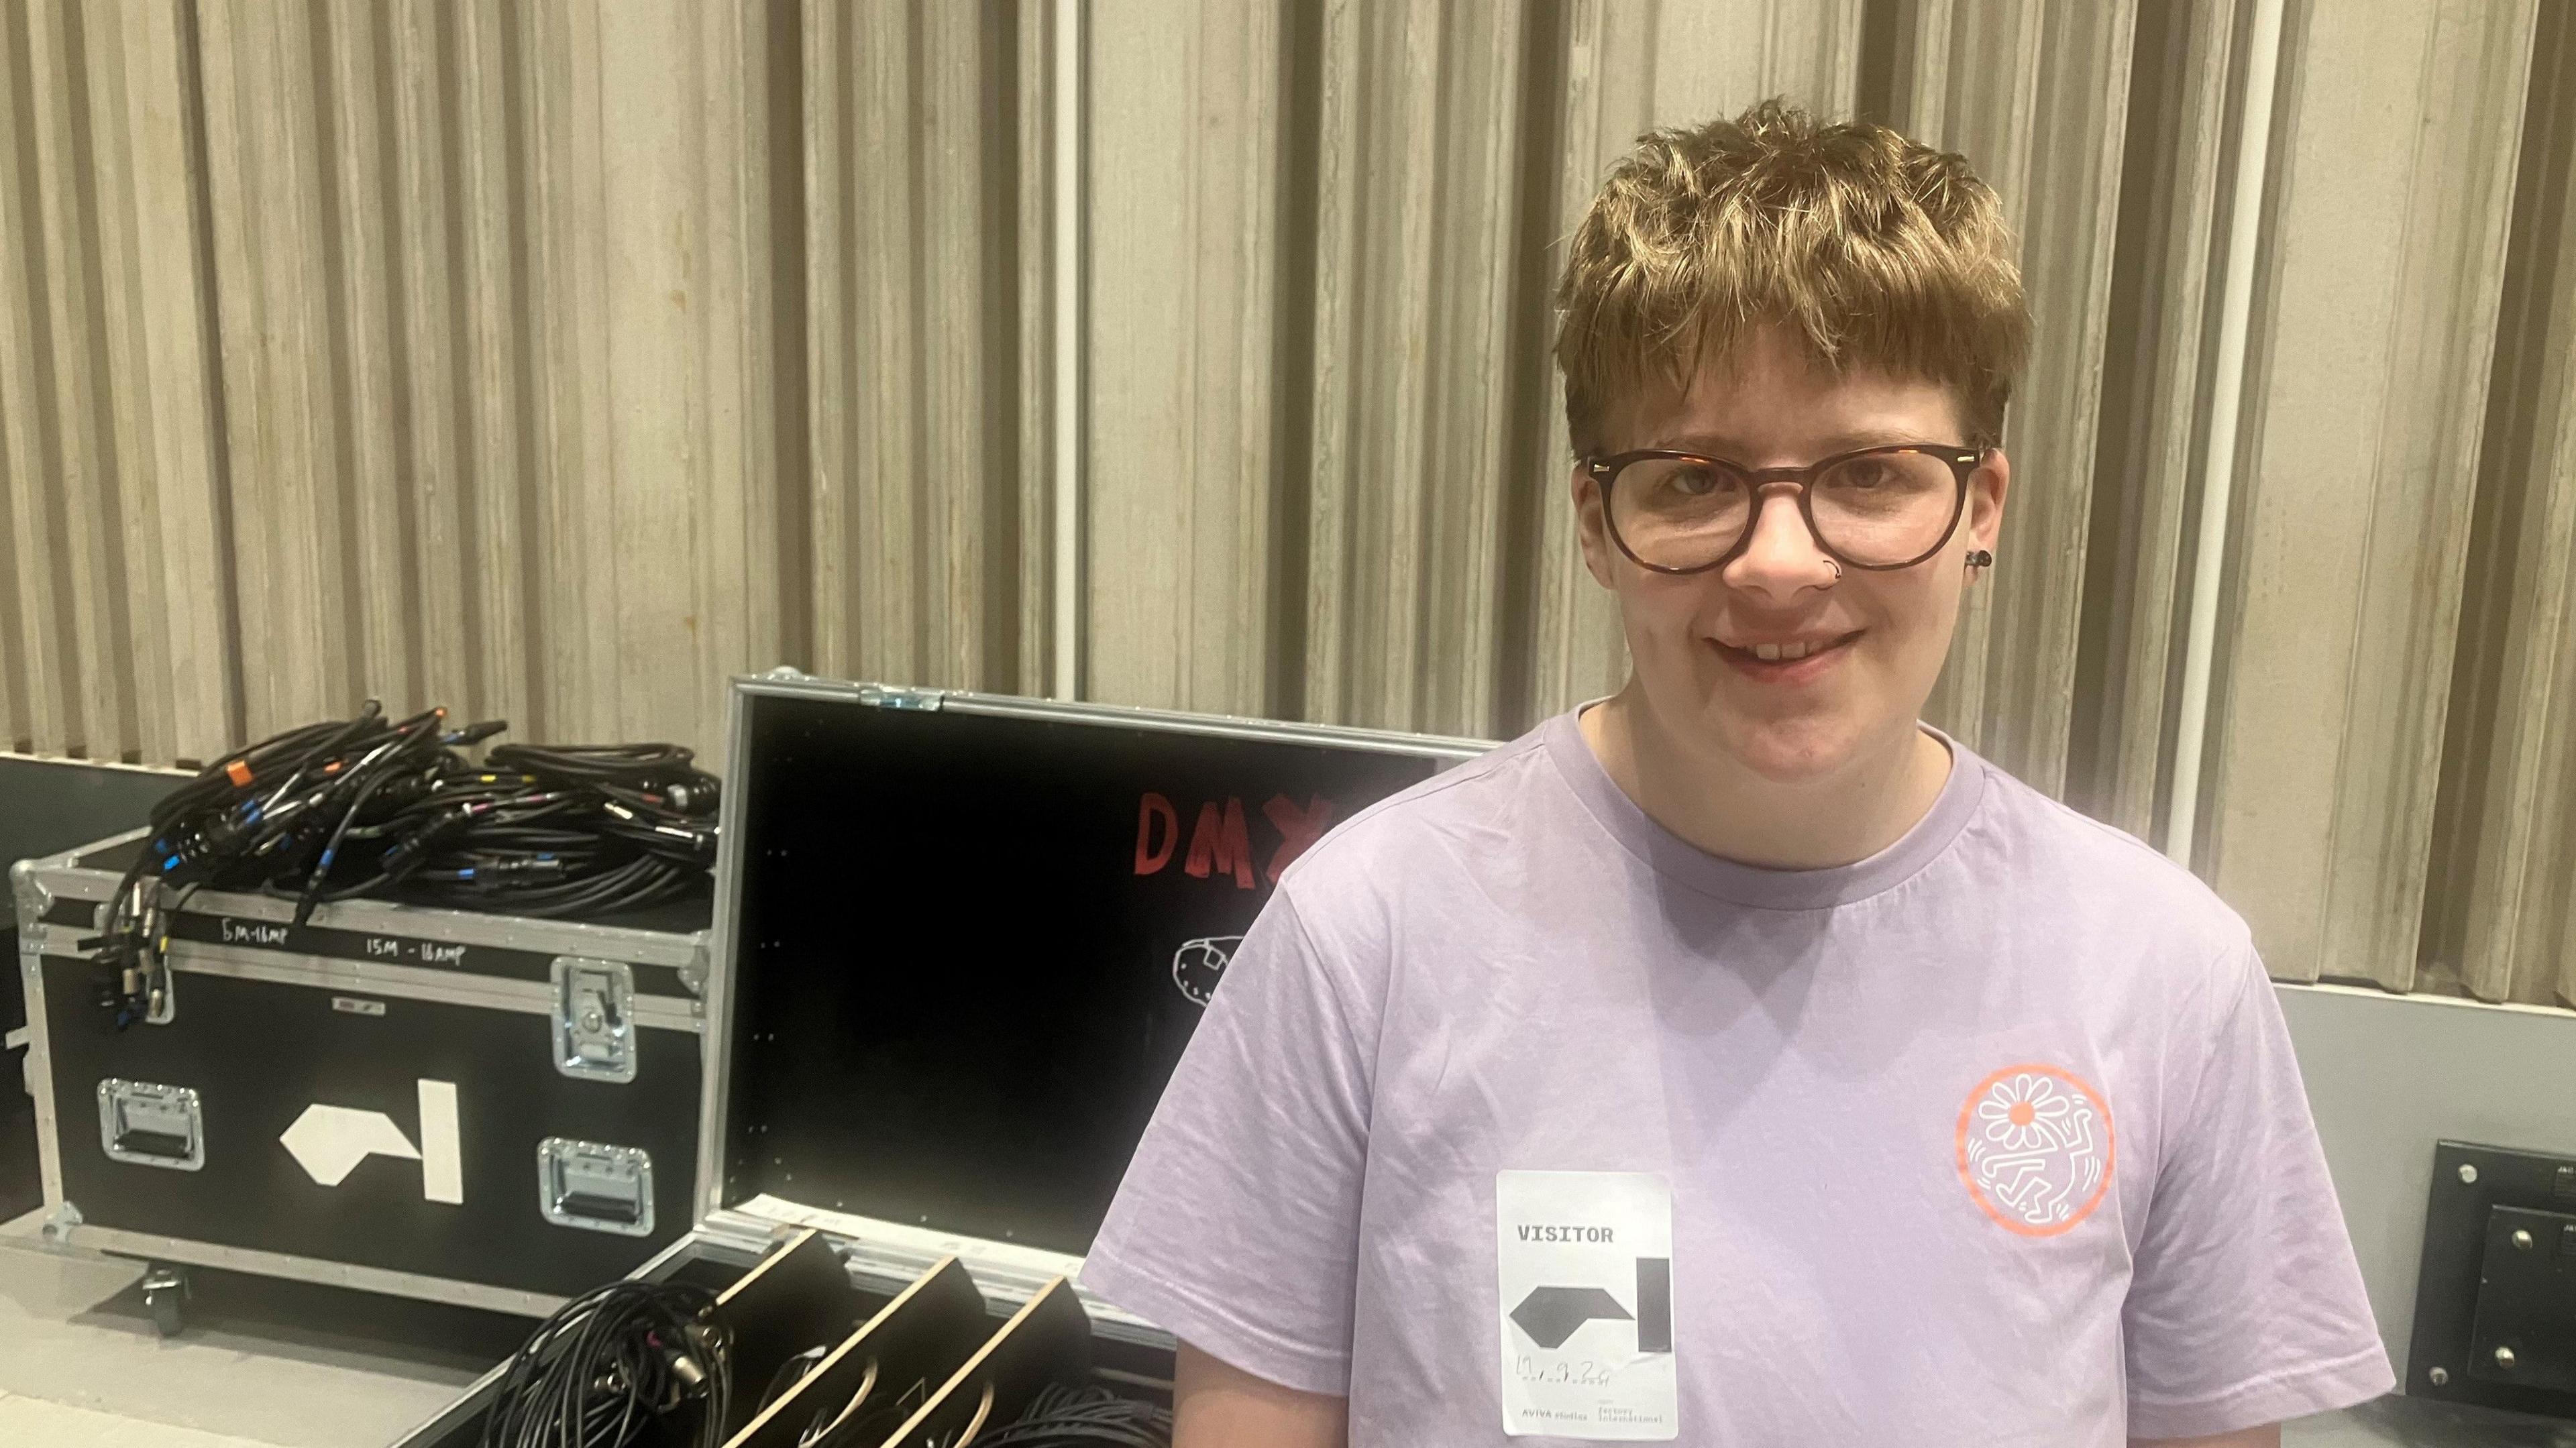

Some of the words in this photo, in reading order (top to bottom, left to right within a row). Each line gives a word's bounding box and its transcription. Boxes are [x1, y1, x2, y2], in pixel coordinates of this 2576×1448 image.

[1135, 792, 1332, 889] DMX
[367, 939, 397, 956] 15M
[1517, 1224, 1614, 1243] VISITOR
[1522, 1409, 1552, 1418] AVIVA
